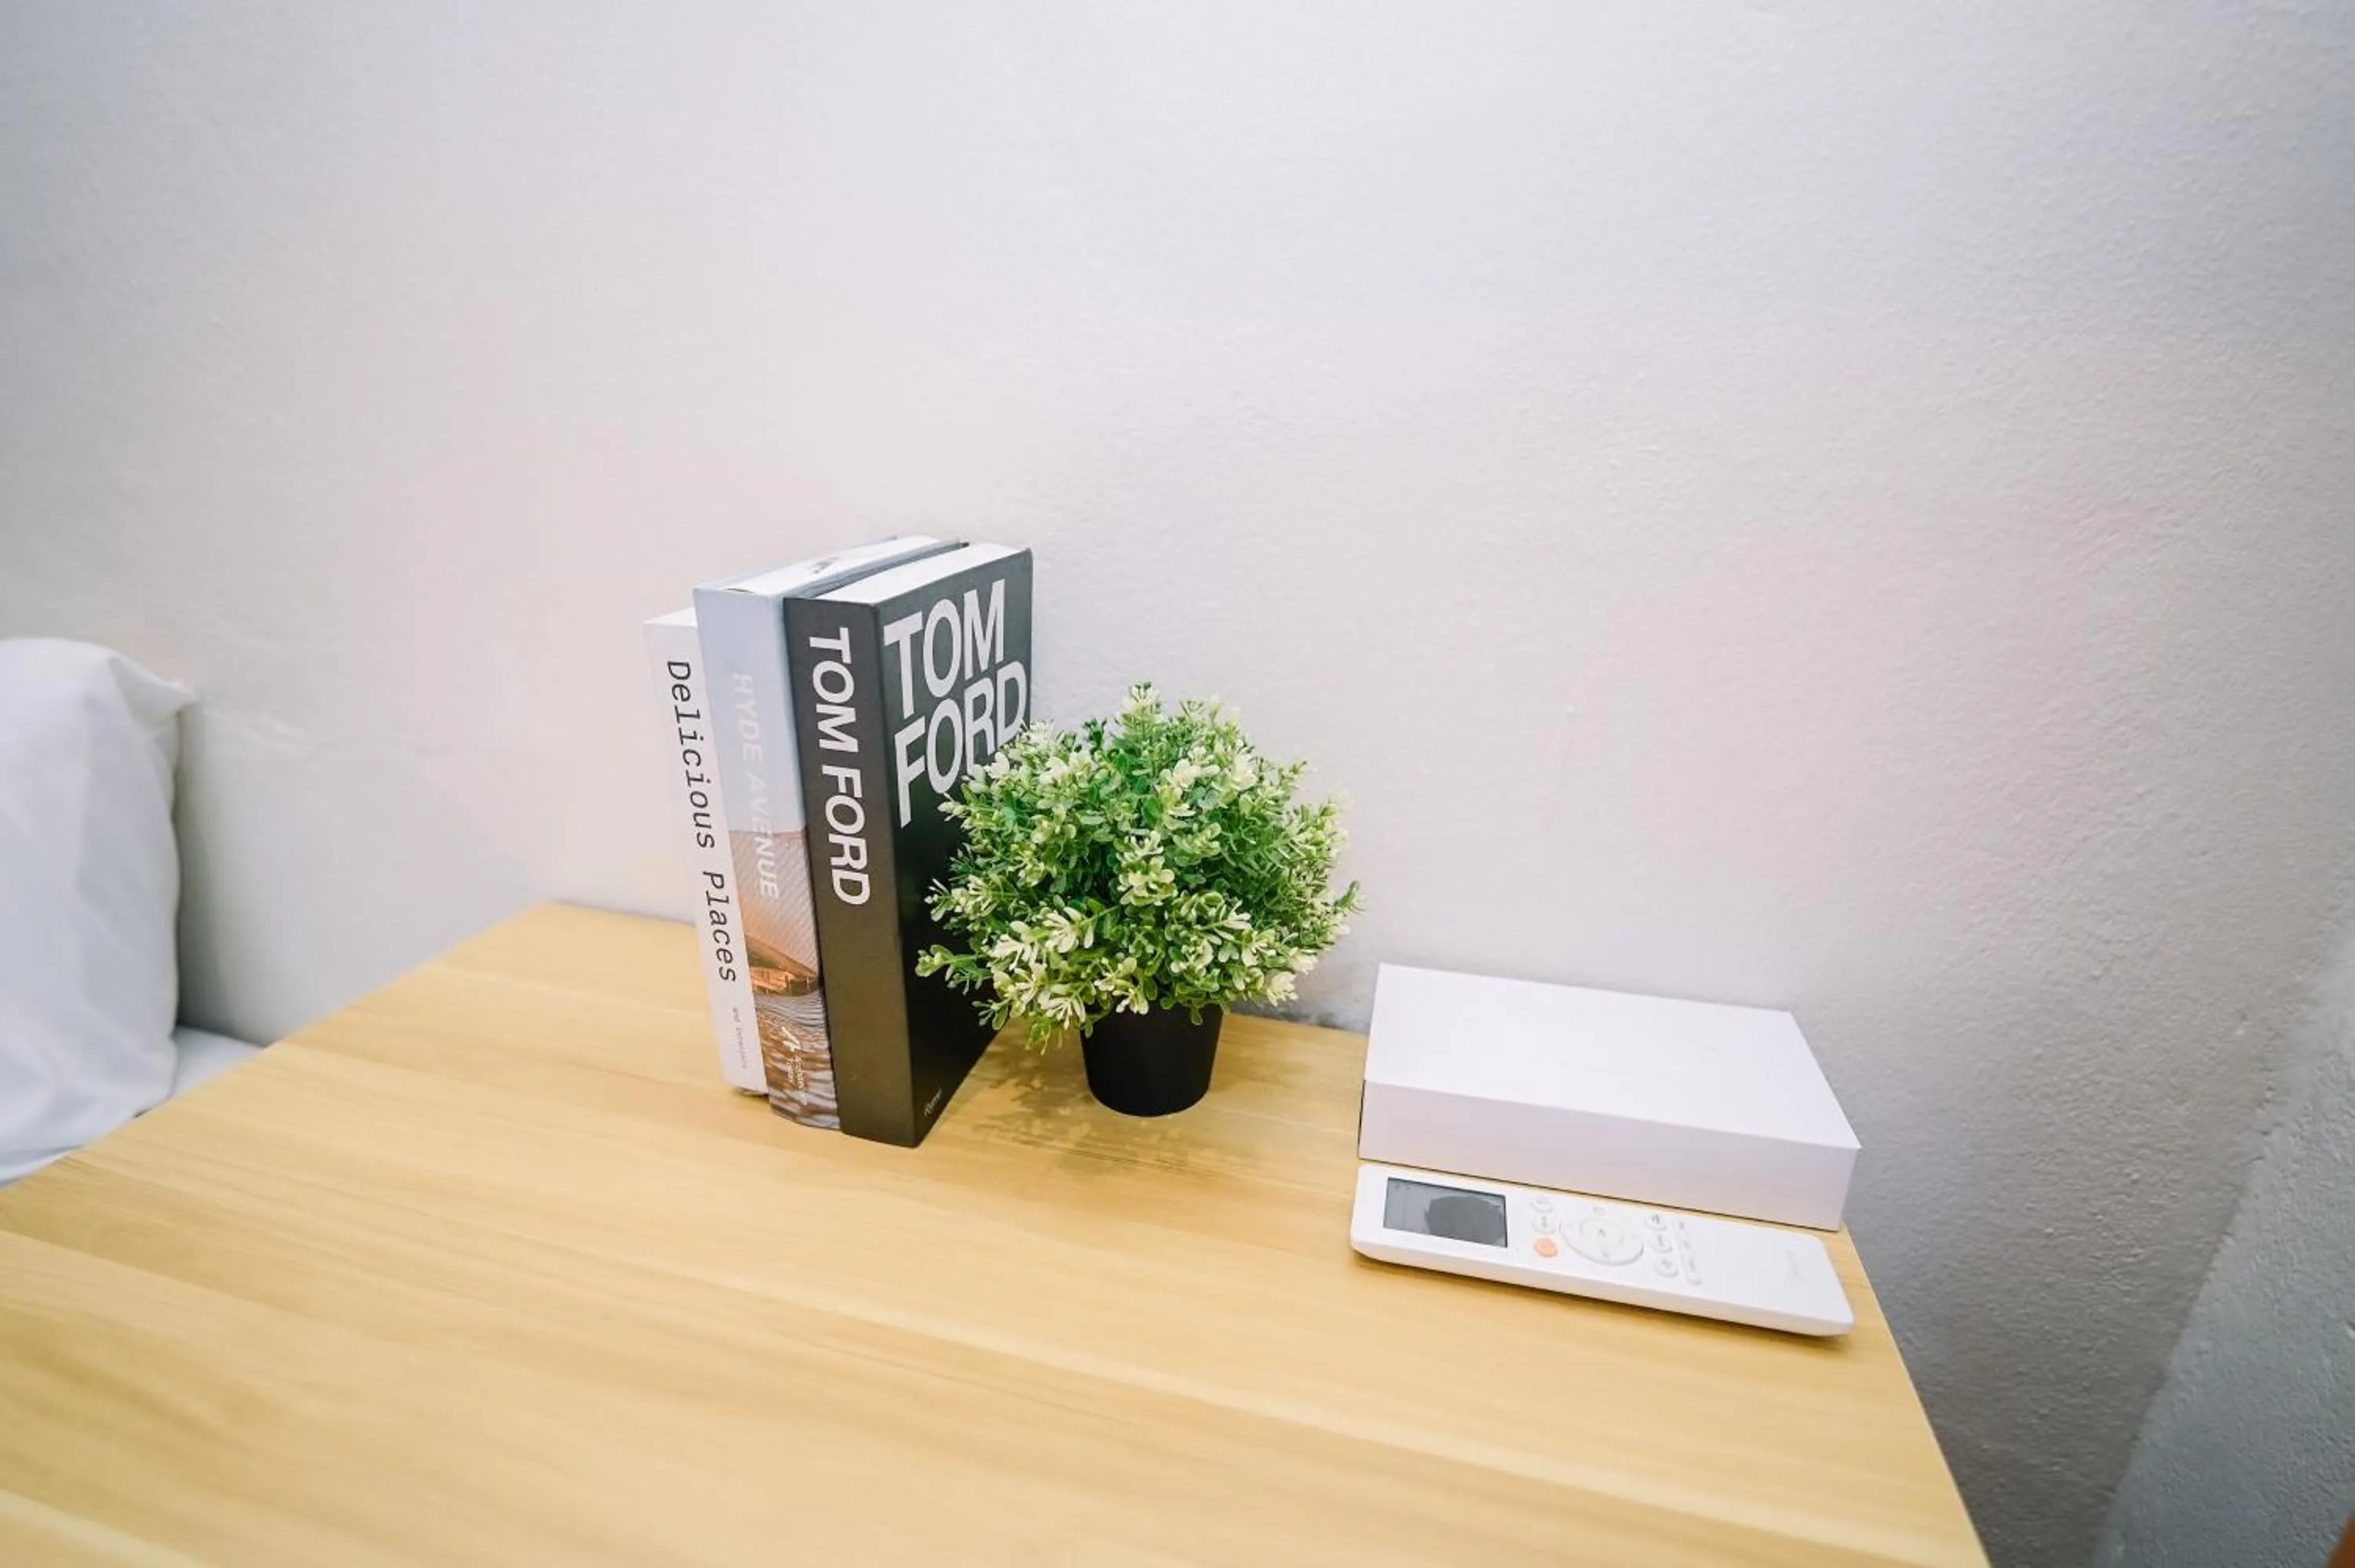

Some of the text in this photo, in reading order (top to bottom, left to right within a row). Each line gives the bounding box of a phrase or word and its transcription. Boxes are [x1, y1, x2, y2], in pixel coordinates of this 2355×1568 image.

[809, 627, 860, 753] TOM
[884, 579, 1006, 719] TOM
[732, 673, 780, 899] HYDE AVENUE
[894, 661, 1027, 828] FORD
[667, 661, 736, 983] Delicious Places
[822, 764, 871, 905] FORD
